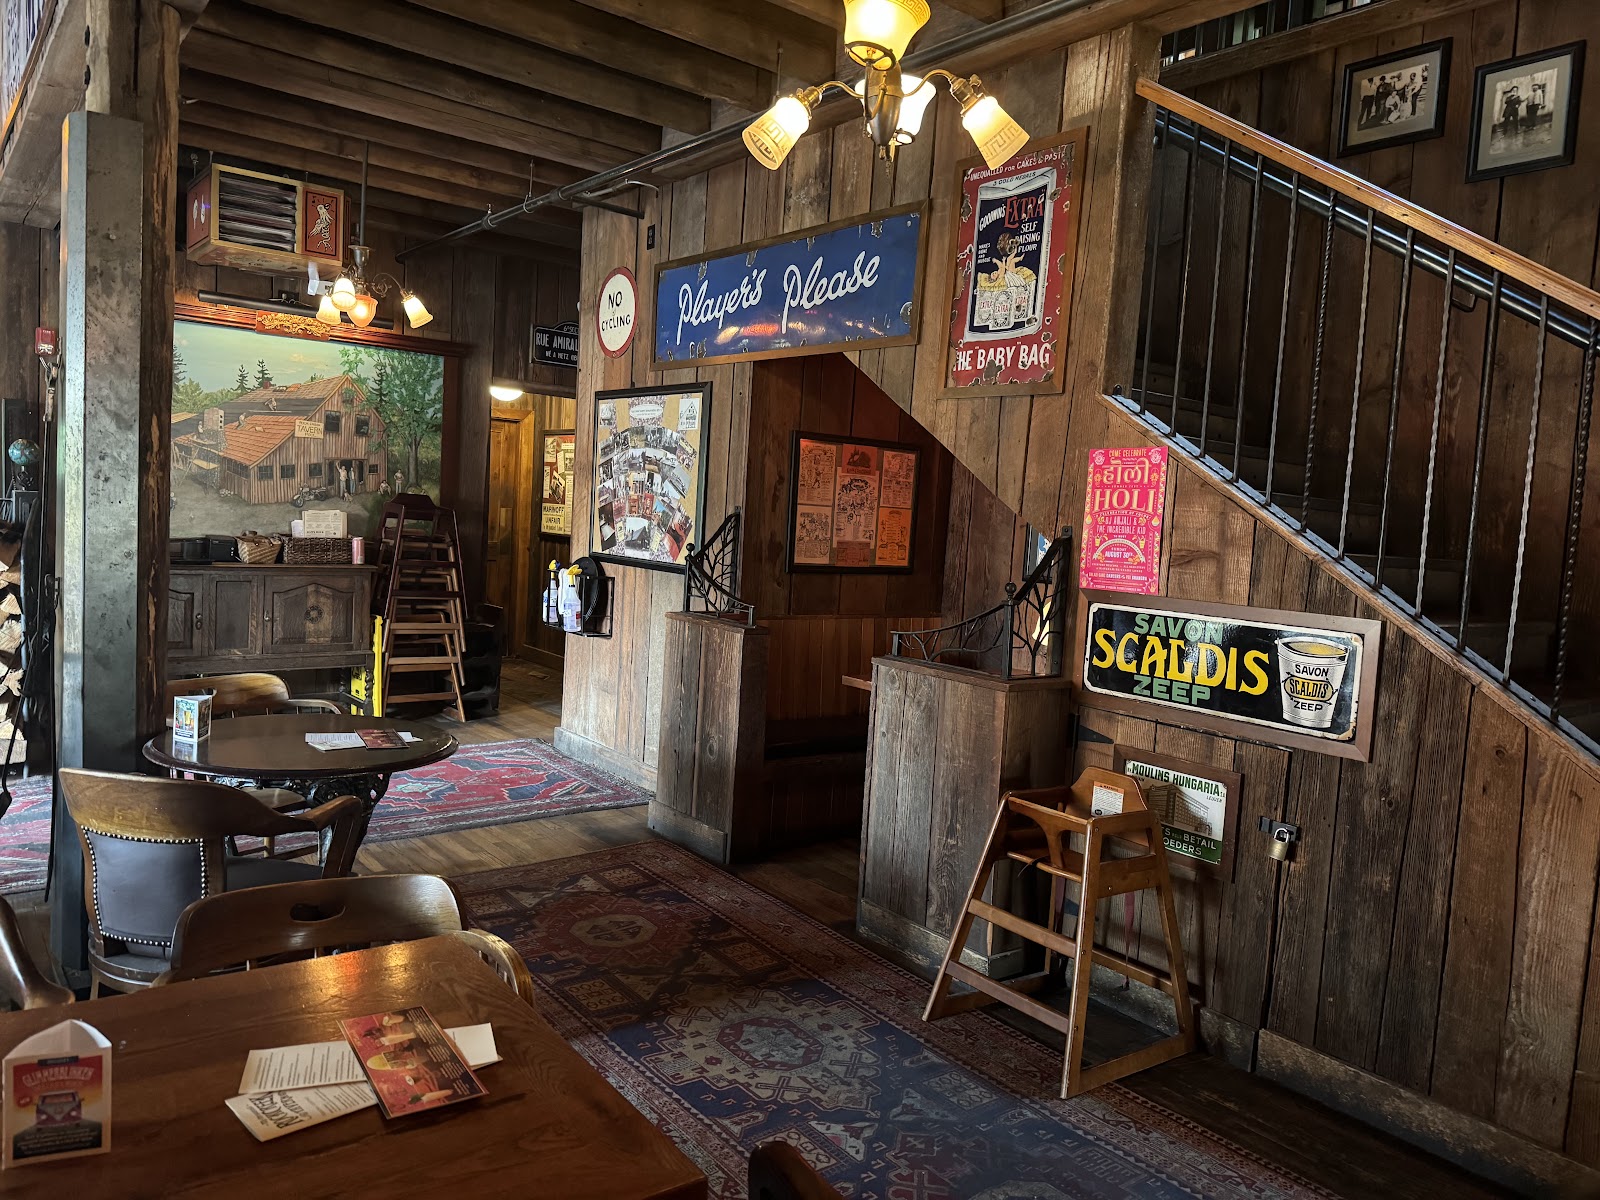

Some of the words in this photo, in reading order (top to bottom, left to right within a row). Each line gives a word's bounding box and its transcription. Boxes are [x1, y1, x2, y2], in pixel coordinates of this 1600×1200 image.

[1020, 221, 1038, 233] SELF
[1018, 244, 1037, 253] FLOUR
[608, 291, 623, 309] NO
[676, 268, 768, 346] Player's
[781, 251, 881, 335] Please
[601, 314, 631, 332] CYCLING
[535, 332, 550, 348] RUE
[552, 335, 578, 352] AMIRAL
[1017, 343, 1051, 370] BAG
[297, 425, 323, 434] TAVERN
[1123, 449, 1147, 457] CELEBRATE
[1102, 457, 1152, 485] होली
[1093, 488, 1156, 513] HOLI
[1097, 525, 1106, 533] THE
[1107, 525, 1136, 534] INCREDIBLE
[1134, 613, 1224, 645] SAVON
[1091, 628, 1270, 696] SCALDIS
[1294, 663, 1330, 678] SAVON
[1133, 674, 1211, 705] ZEEP
[1289, 679, 1330, 699] SCALDIS
[1293, 699, 1324, 712] ZEEP
[1131, 763, 1170, 783] MOULINS
[1172, 773, 1220, 797] HUNGARIA
[1162, 837, 1202, 856] OEDERS
